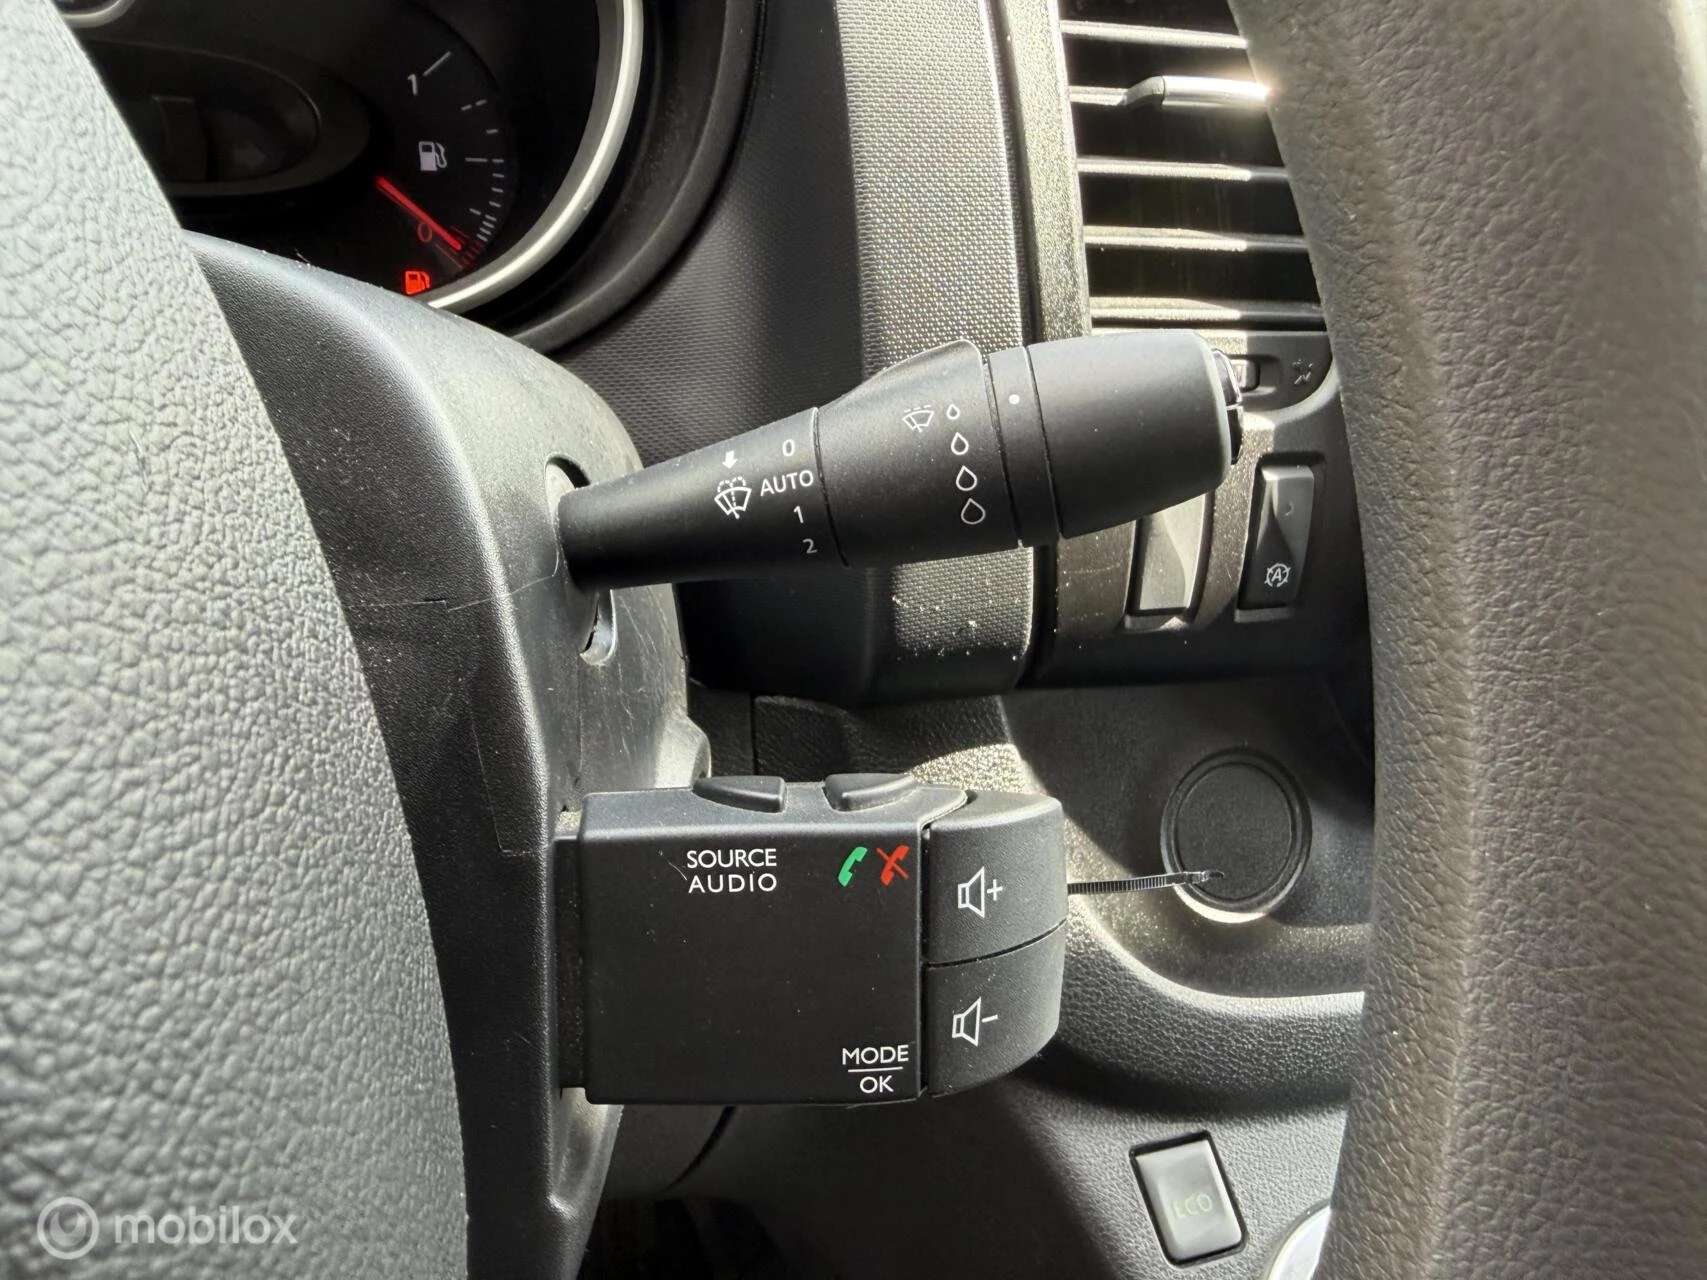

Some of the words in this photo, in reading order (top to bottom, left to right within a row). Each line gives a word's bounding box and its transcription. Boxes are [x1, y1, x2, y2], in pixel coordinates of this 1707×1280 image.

[782, 439, 795, 457] 0
[760, 469, 814, 497] AUTO
[793, 505, 804, 524] 1
[802, 538, 818, 554] 2
[686, 848, 777, 869] SOURCE
[688, 873, 777, 894] AUDIO
[842, 1044, 910, 1066] MODE
[859, 1075, 894, 1094] OK
[1172, 1193, 1213, 1219] ECO
